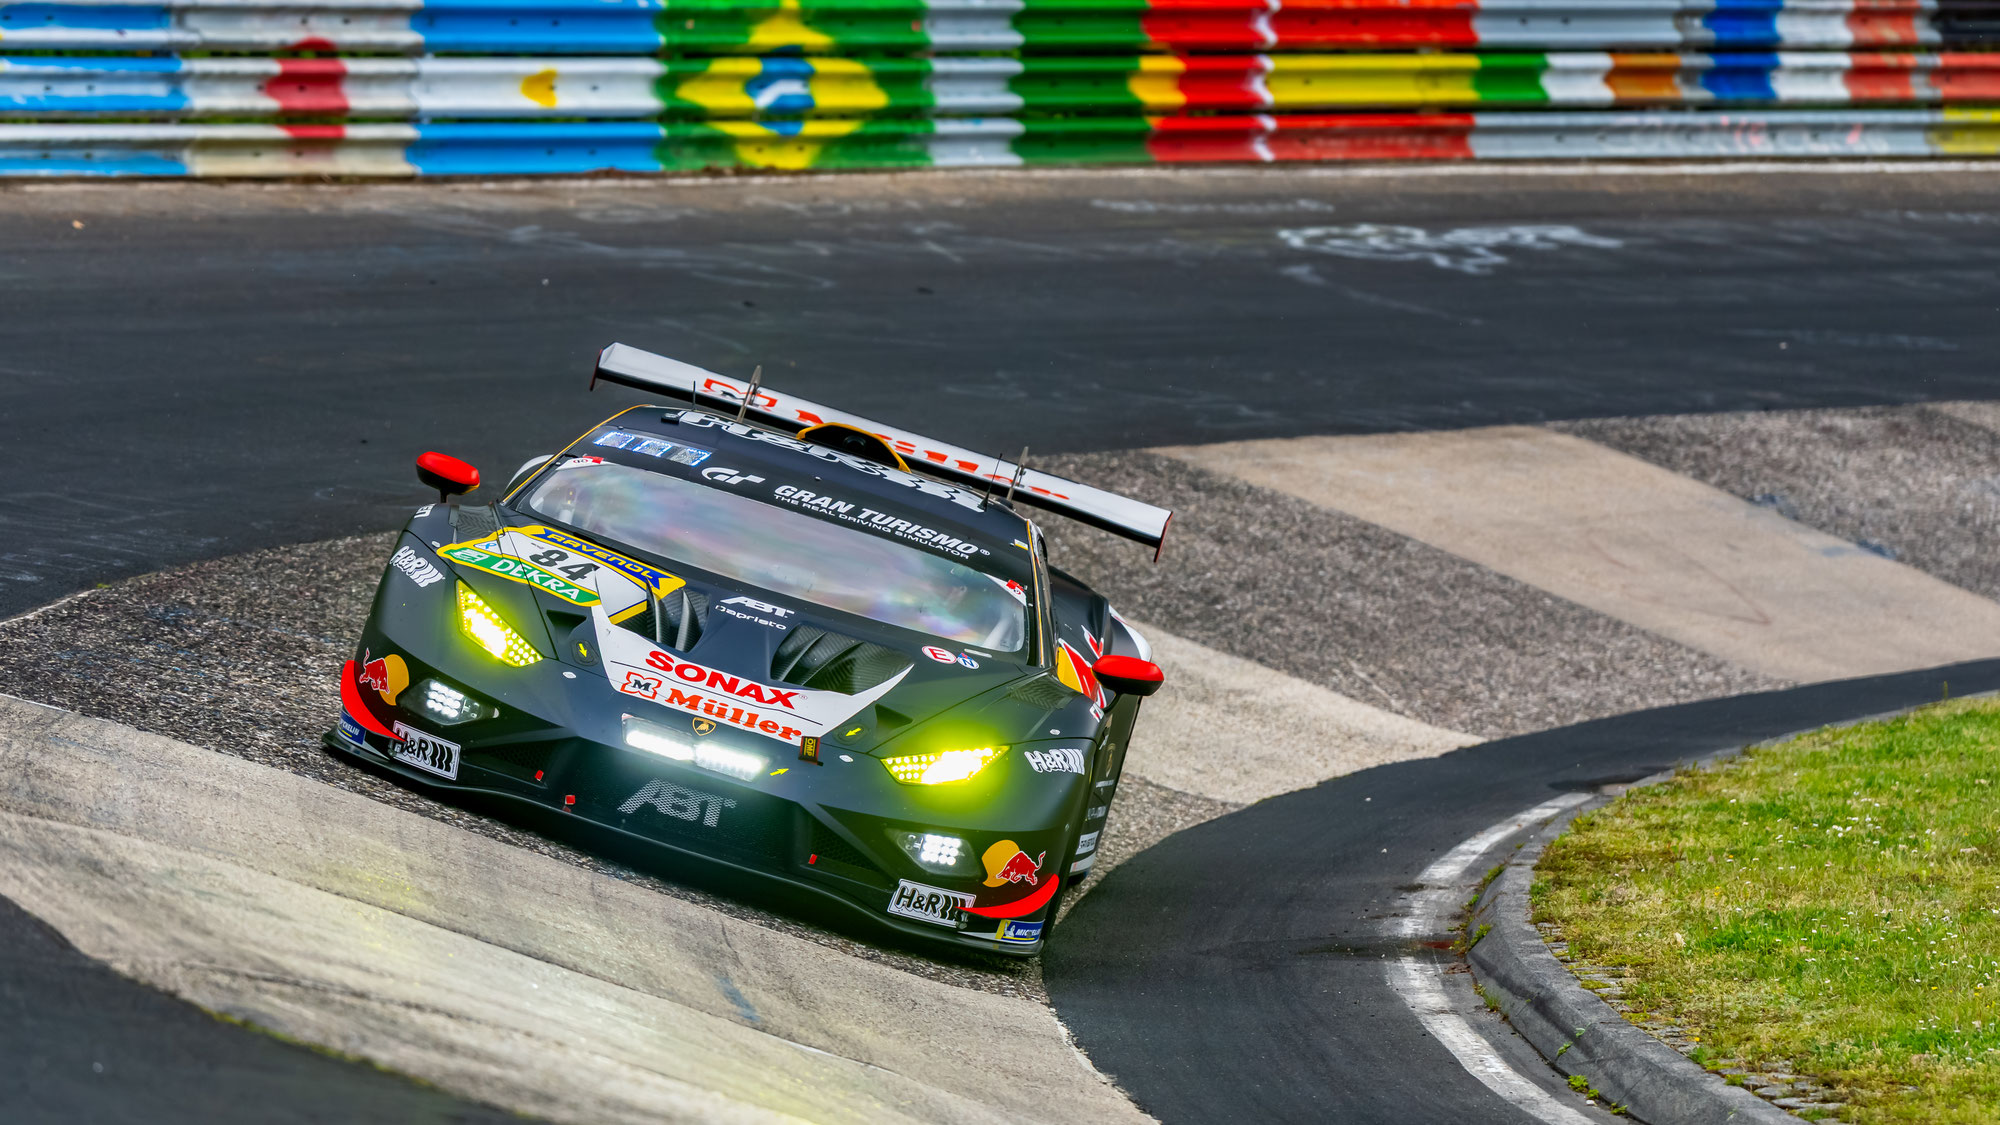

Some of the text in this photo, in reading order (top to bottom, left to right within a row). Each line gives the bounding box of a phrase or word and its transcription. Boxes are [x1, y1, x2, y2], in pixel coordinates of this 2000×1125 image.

[701, 467, 766, 486] GT
[774, 485, 979, 555] GRAN TURISMO
[774, 494, 970, 560] THE REAL DRIVING SIMULATOR
[529, 549, 600, 581] 84
[547, 533, 654, 579] RAVENOL
[490, 559, 582, 601] DEKRA
[720, 596, 795, 619] ABT
[645, 650, 799, 710] SONAX
[664, 687, 802, 740] Müller
[1024, 749, 1071, 773] H&R
[617, 777, 738, 828] ABT
[895, 885, 943, 917] H&R
